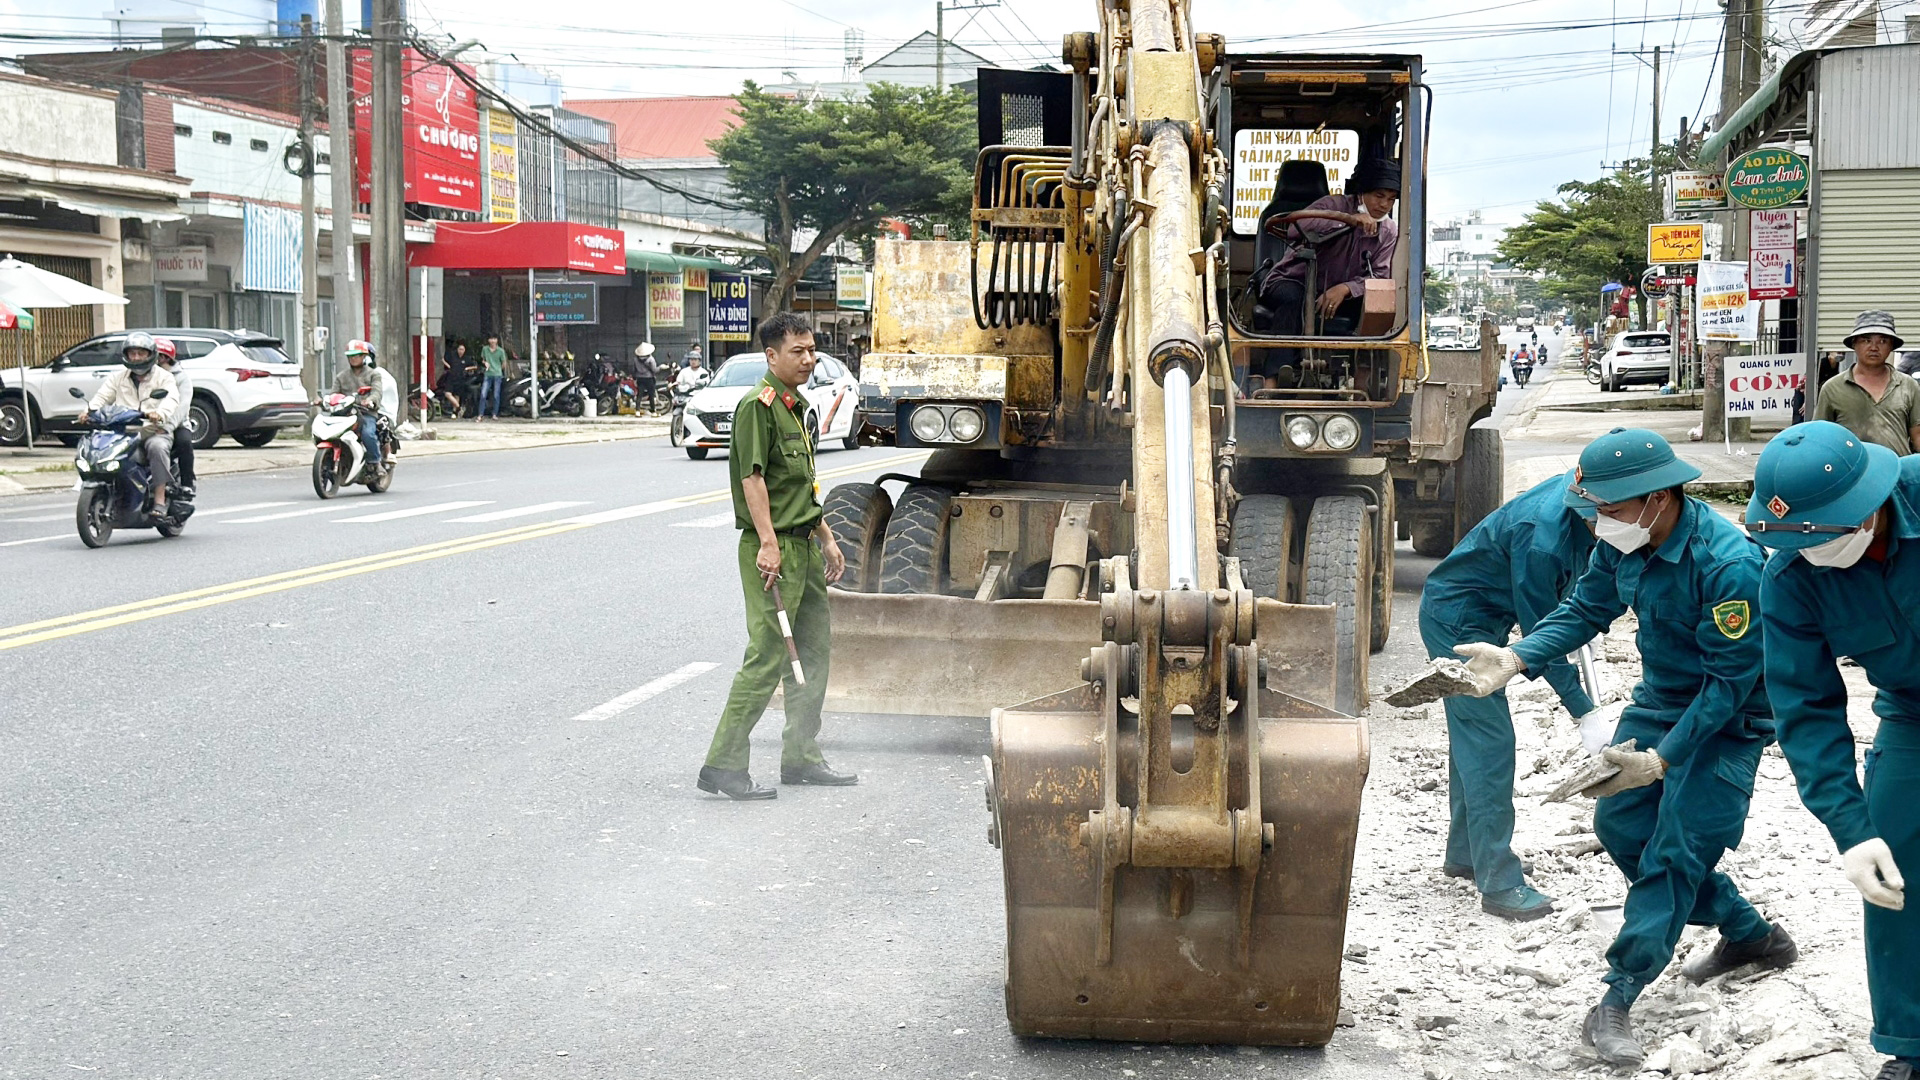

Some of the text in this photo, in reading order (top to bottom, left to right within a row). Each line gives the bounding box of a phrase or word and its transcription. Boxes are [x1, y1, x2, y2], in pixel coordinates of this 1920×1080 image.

[420, 124, 478, 152] CHƯƠNG
[1743, 154, 1791, 168] ÁO DÀI
[1731, 164, 1804, 186] Lan Anh
[1678, 188, 1698, 198] Minh
[1757, 211, 1788, 225] Uyên
[156, 255, 204, 270] THUỐC TÂY
[710, 276, 747, 301] VỊT CỎ
[1727, 294, 1745, 306] 12K
[1740, 359, 1793, 369] QUANG HUY
[1730, 372, 1800, 392] CƠM
